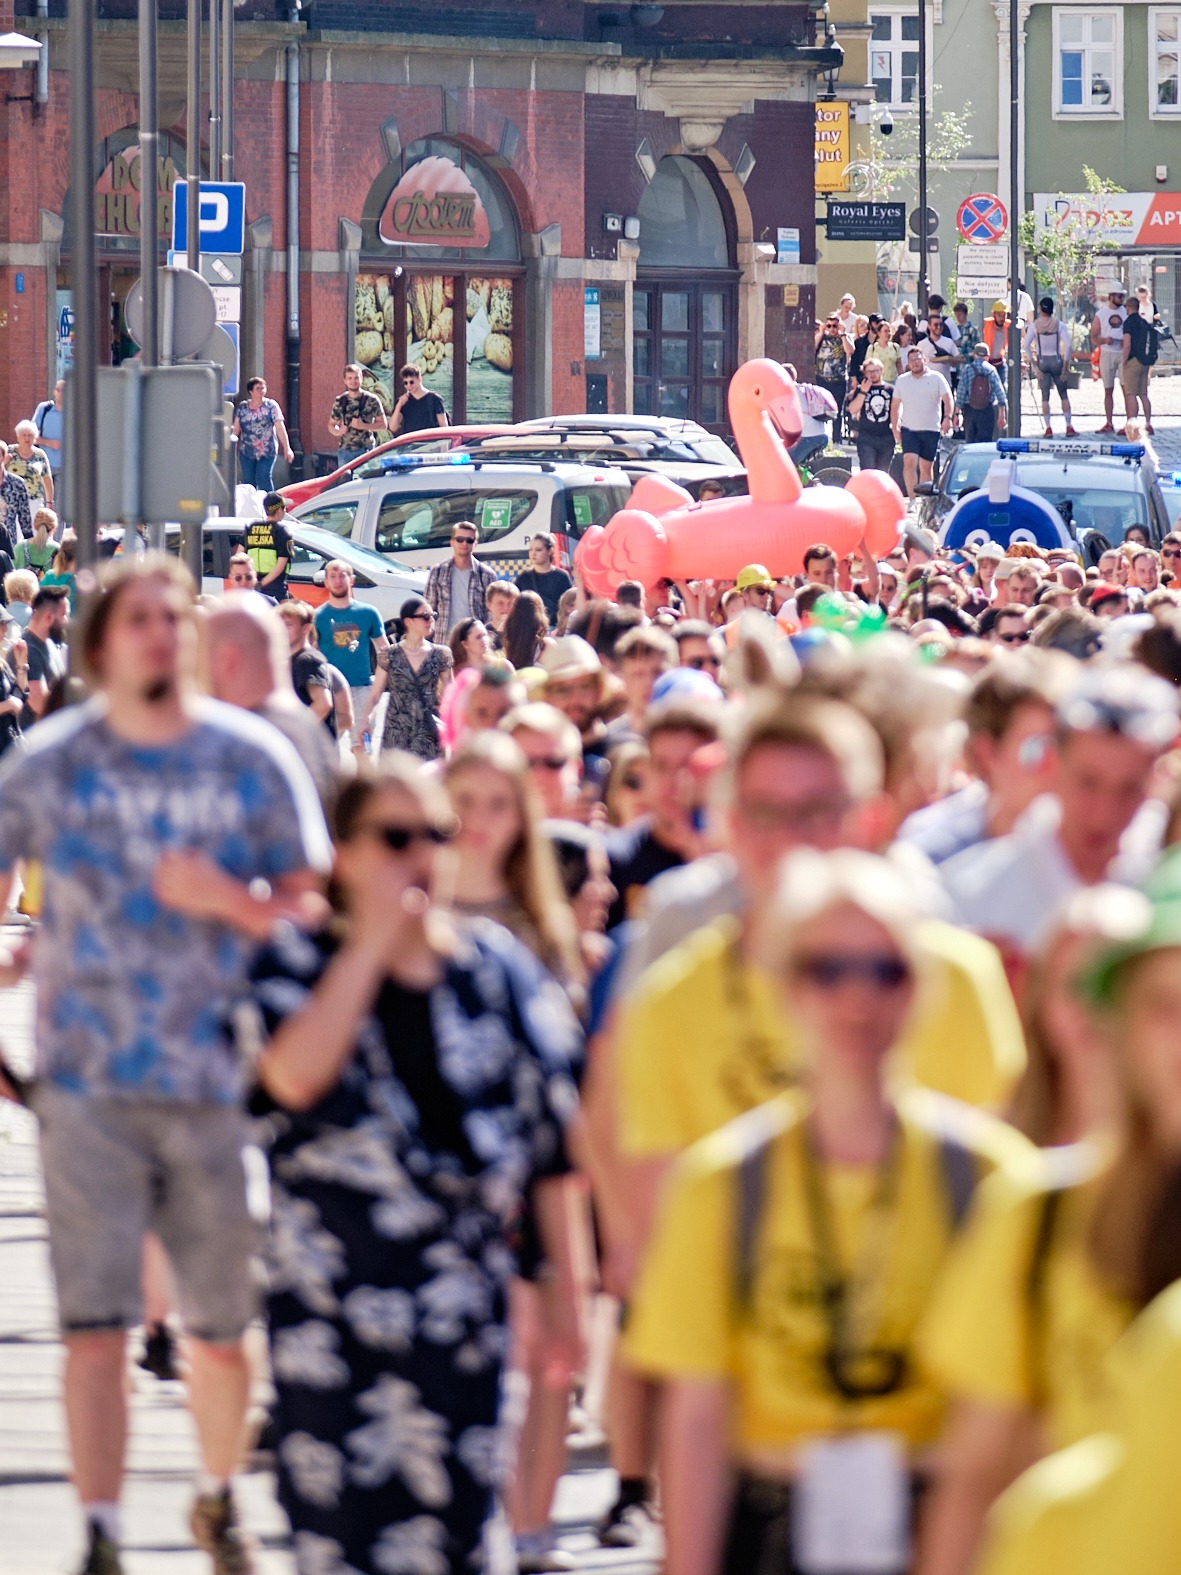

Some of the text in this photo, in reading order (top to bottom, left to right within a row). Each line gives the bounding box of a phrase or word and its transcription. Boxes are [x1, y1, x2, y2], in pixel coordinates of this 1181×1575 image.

[198, 192, 228, 232] P
[832, 205, 901, 219] Royal Eyes
[252, 524, 273, 534] STRAŻ
[248, 535, 274, 545] MIEJSKA
